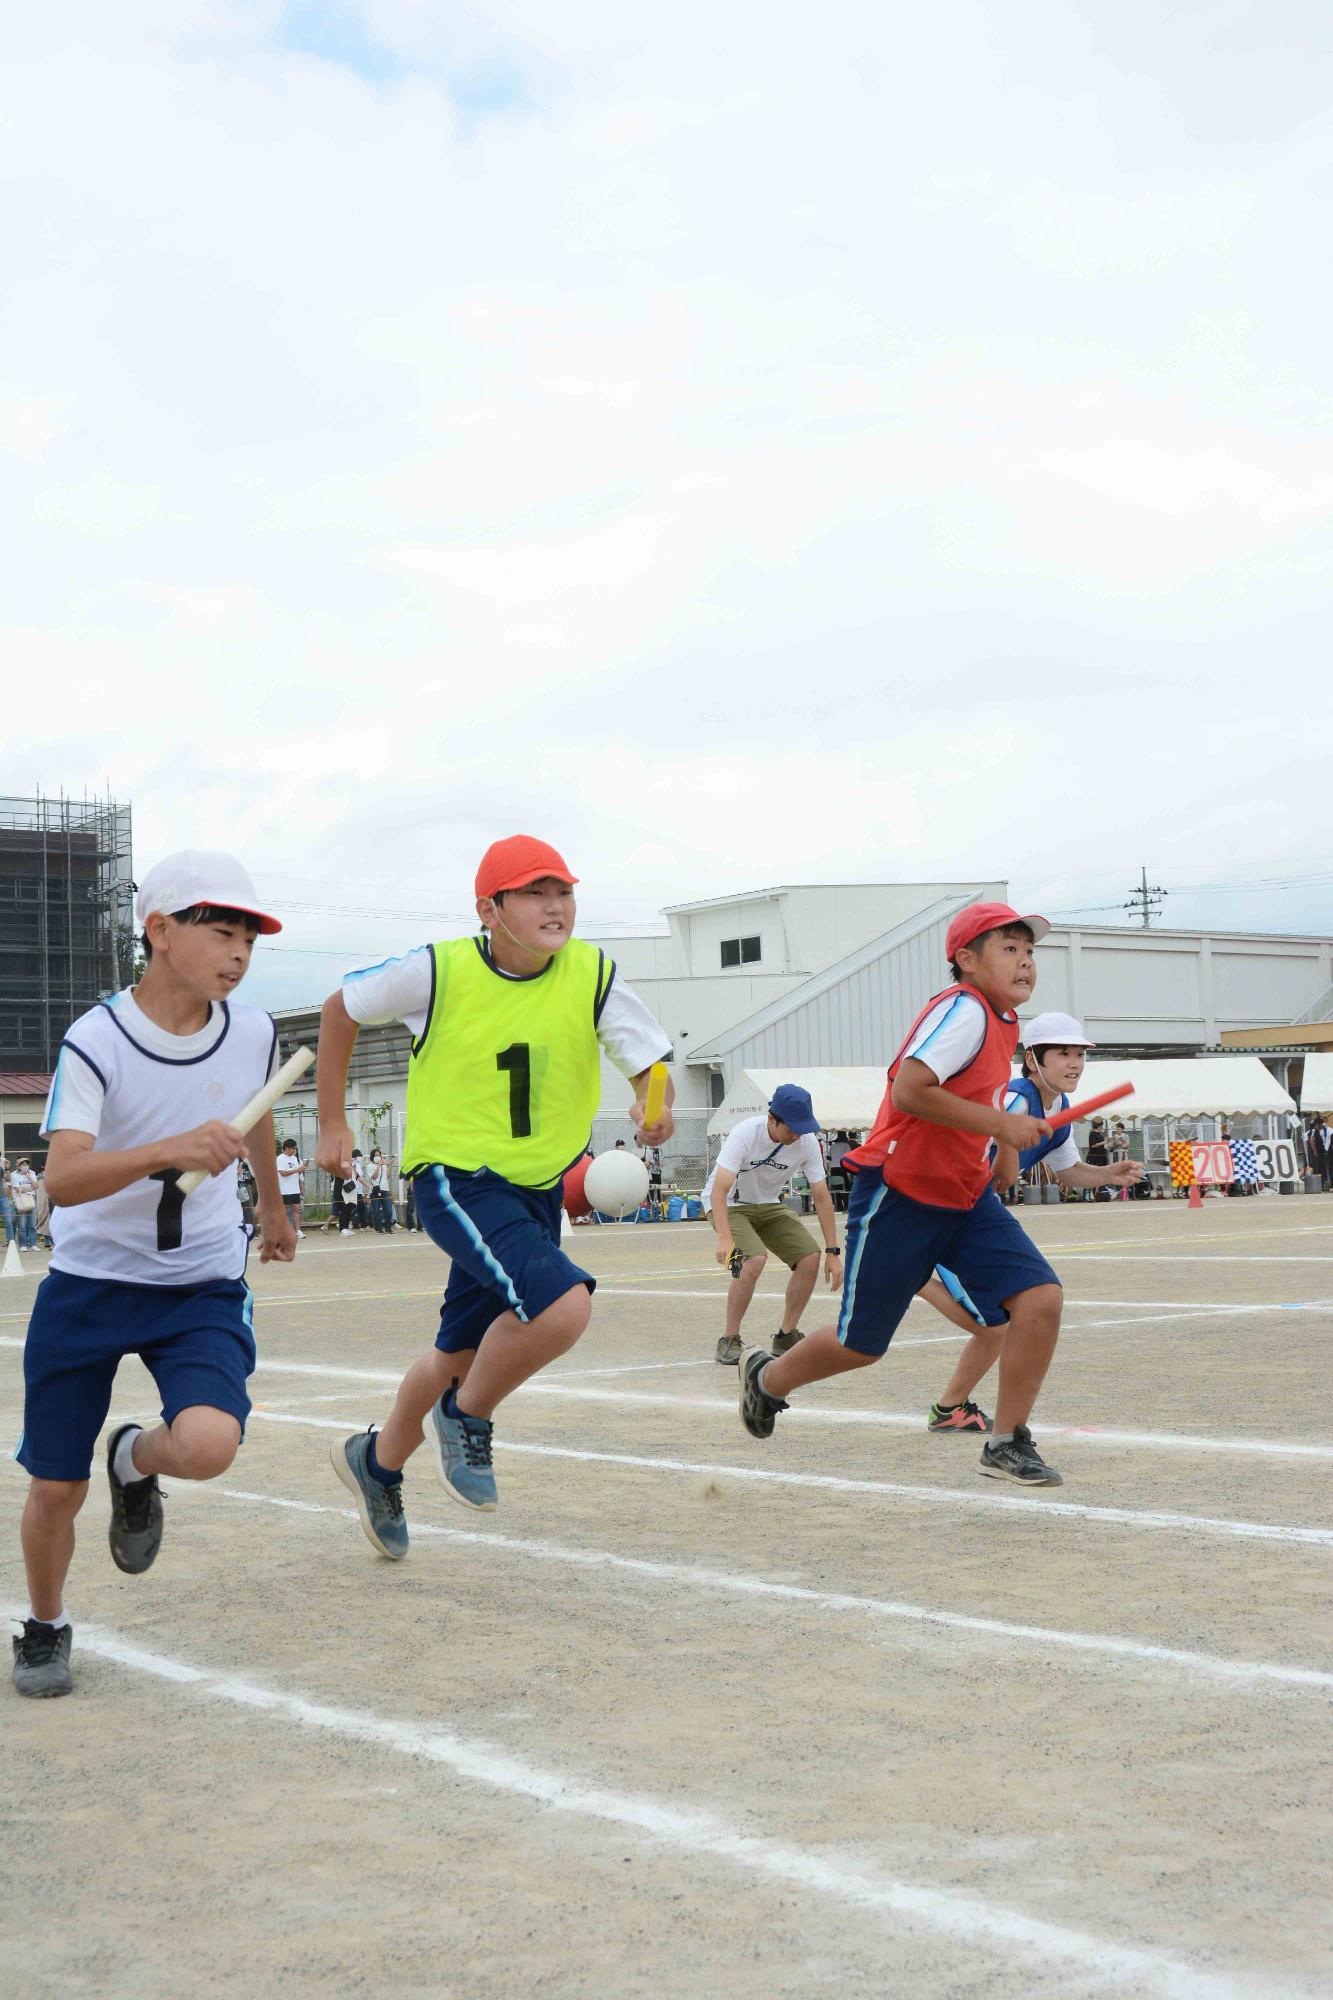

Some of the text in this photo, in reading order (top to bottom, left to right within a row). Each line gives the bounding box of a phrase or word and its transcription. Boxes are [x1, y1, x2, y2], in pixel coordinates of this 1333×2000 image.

[496, 1042, 531, 1138] 1
[1194, 1147, 1232, 1182] 20
[1257, 1145, 1294, 1179] 30
